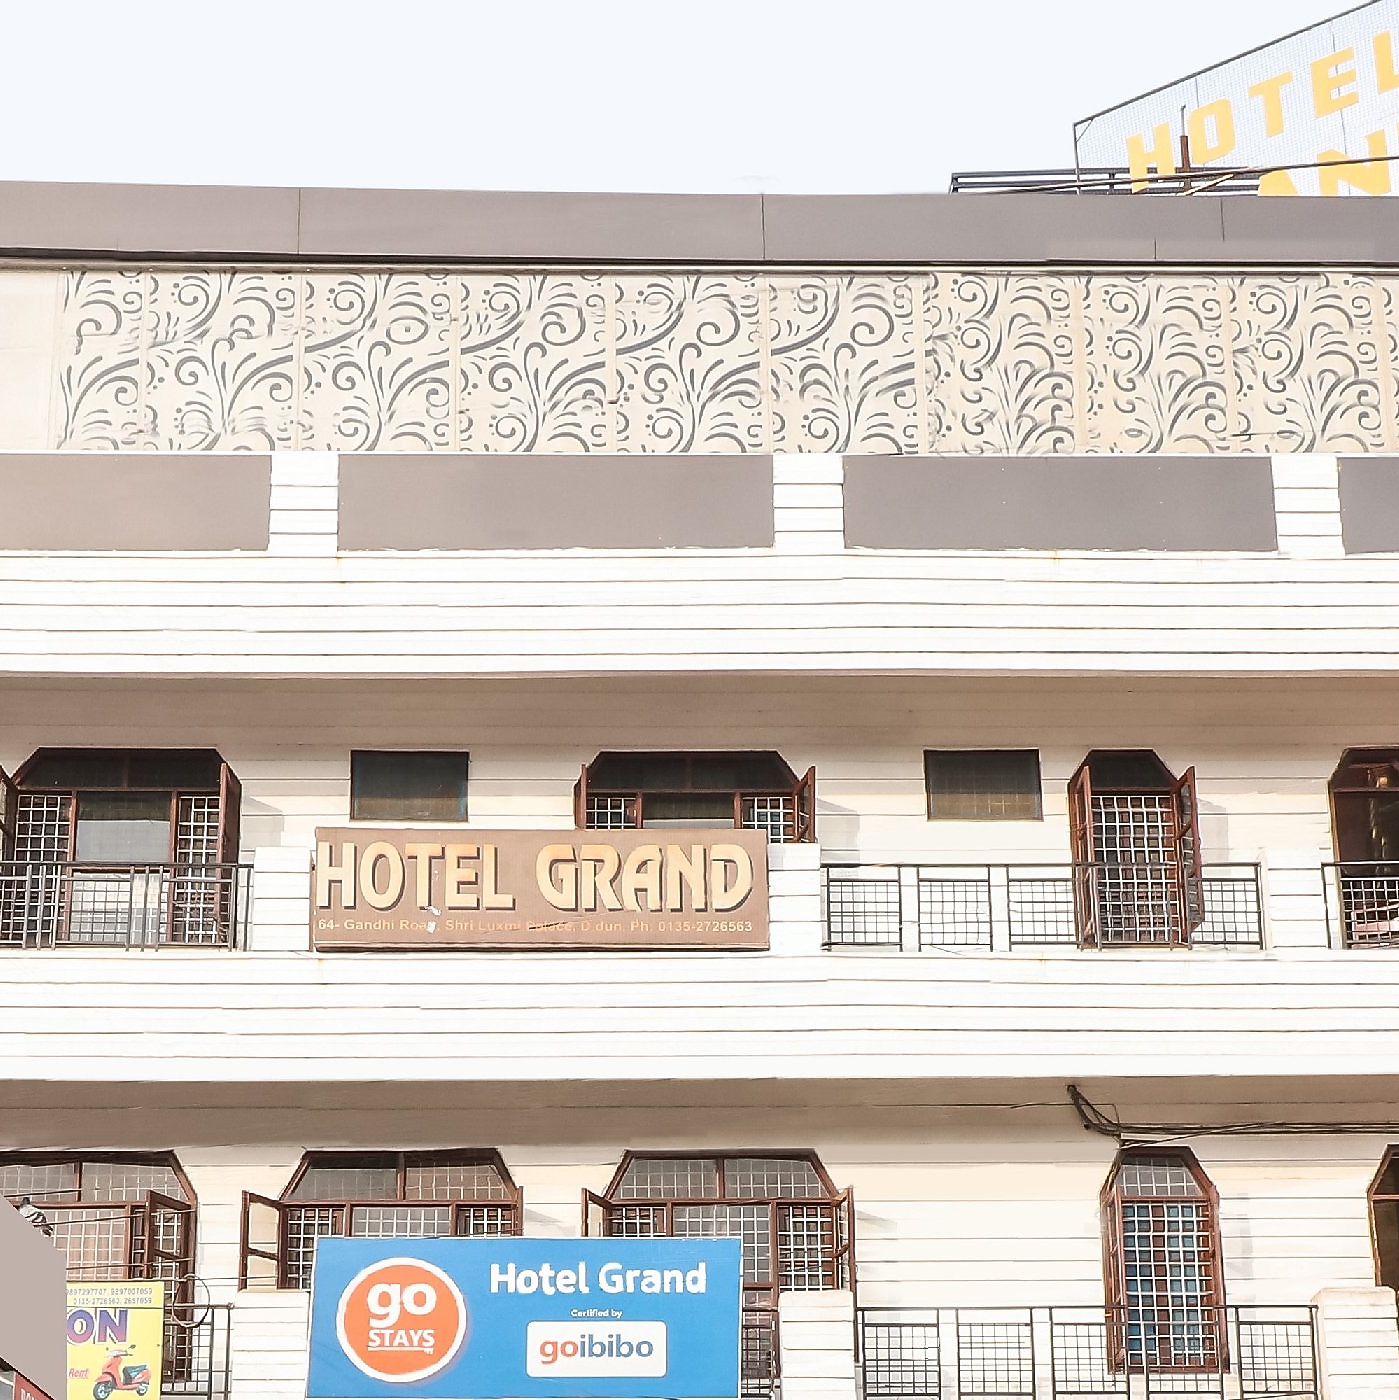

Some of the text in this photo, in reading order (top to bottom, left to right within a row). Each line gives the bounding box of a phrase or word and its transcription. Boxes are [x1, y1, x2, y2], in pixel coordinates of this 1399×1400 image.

[316, 841, 754, 913] HOTEL GRAND
[344, 918, 396, 932] Gandhi
[445, 918, 474, 931] Shri
[657, 919, 754, 932] 0135-2726563
[489, 1262, 707, 1295] Hotel Grand
[368, 1281, 437, 1330] go
[570, 1308, 623, 1320] Certified by
[368, 1329, 436, 1349] STAYS
[539, 1331, 655, 1365] goibibo
